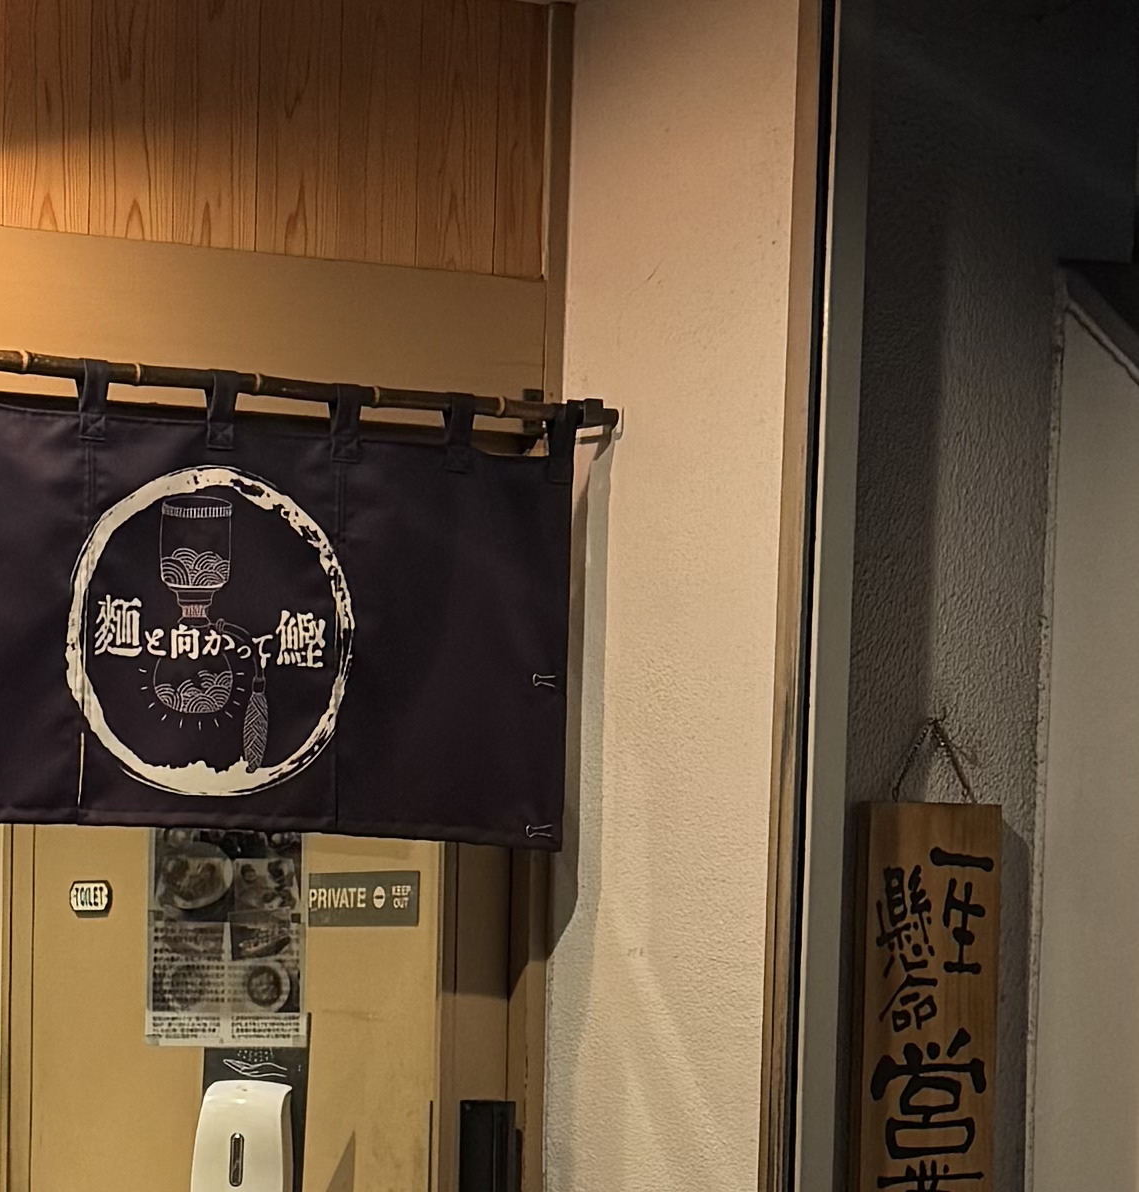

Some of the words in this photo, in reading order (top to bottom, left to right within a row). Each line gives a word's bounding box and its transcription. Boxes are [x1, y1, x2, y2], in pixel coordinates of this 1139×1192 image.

[73, 886, 105, 907] TOILET
[309, 887, 367, 909] PRIVATE
[392, 885, 411, 896] KEEP
[393, 896, 409, 909] OUT
